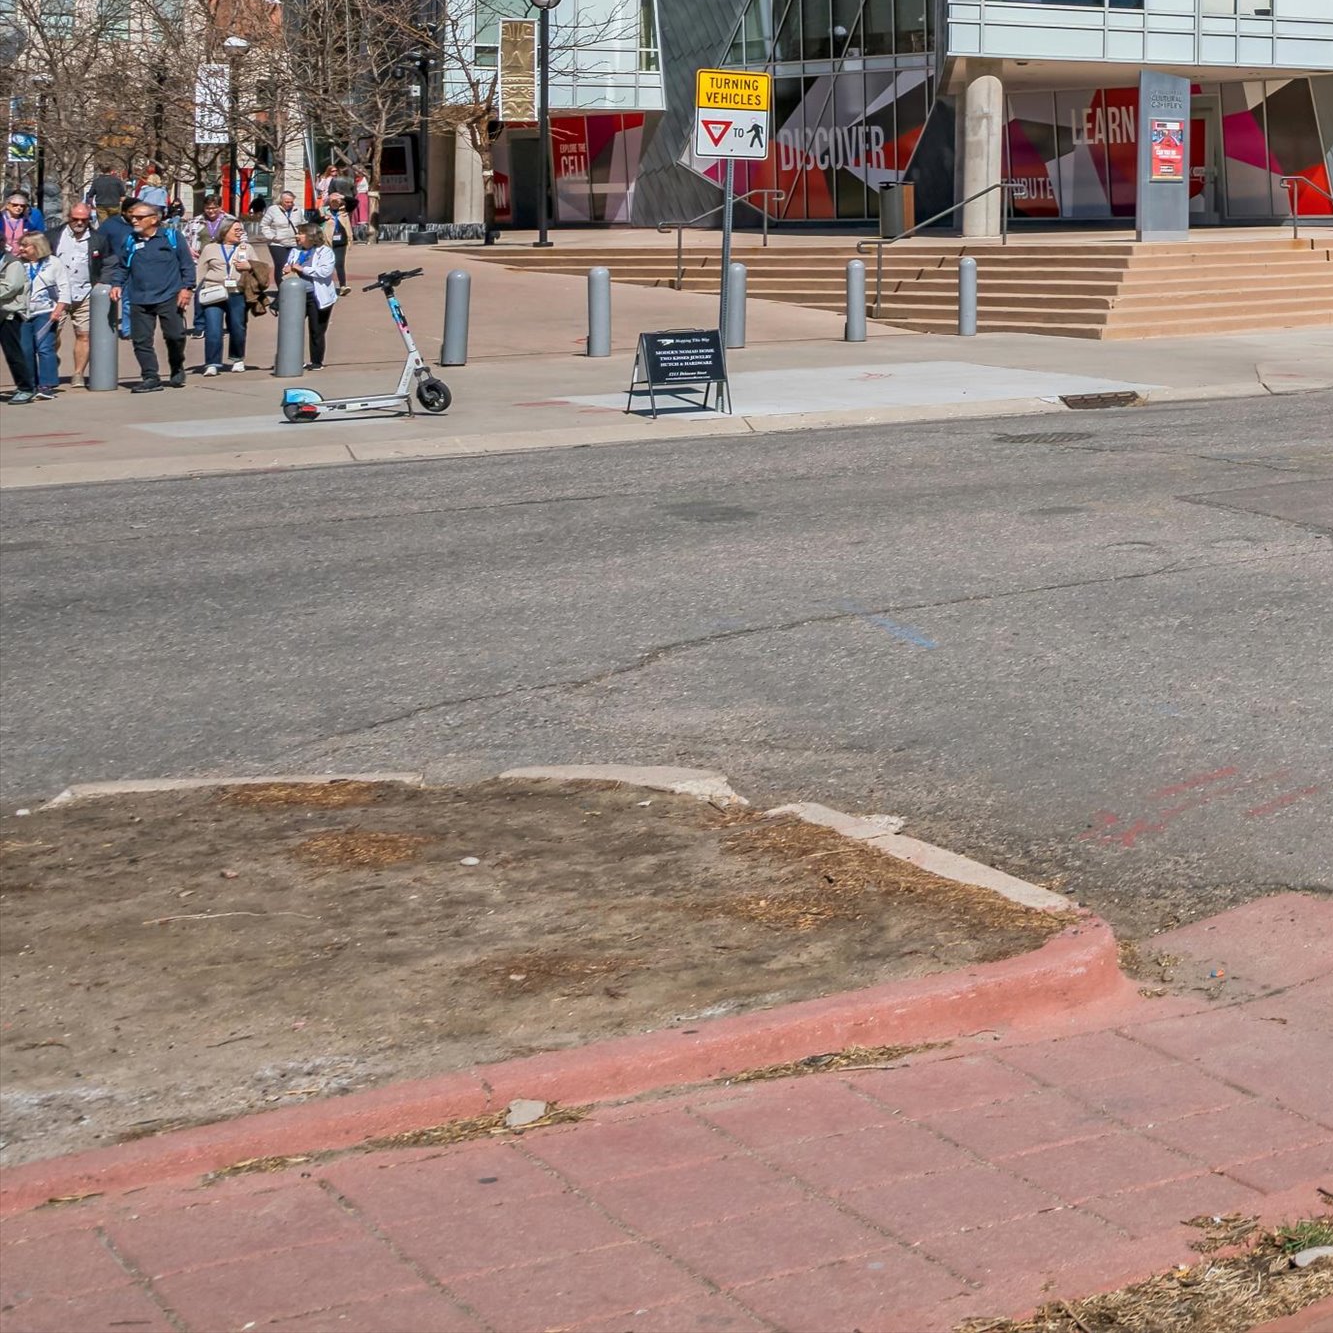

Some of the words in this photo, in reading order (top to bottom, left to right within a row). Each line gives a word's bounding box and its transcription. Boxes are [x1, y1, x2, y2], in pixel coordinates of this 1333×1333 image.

[709, 77, 759, 91] TURNING
[706, 92, 762, 106] VEHICLES
[1151, 94, 1182, 102] CULTURAL
[733, 127, 744, 138] TO
[1071, 106, 1136, 145] LEARN
[559, 143, 578, 153] EXPLORE
[578, 142, 587, 152] THE
[779, 126, 886, 171] DISCOVER
[560, 155, 588, 181] CELL
